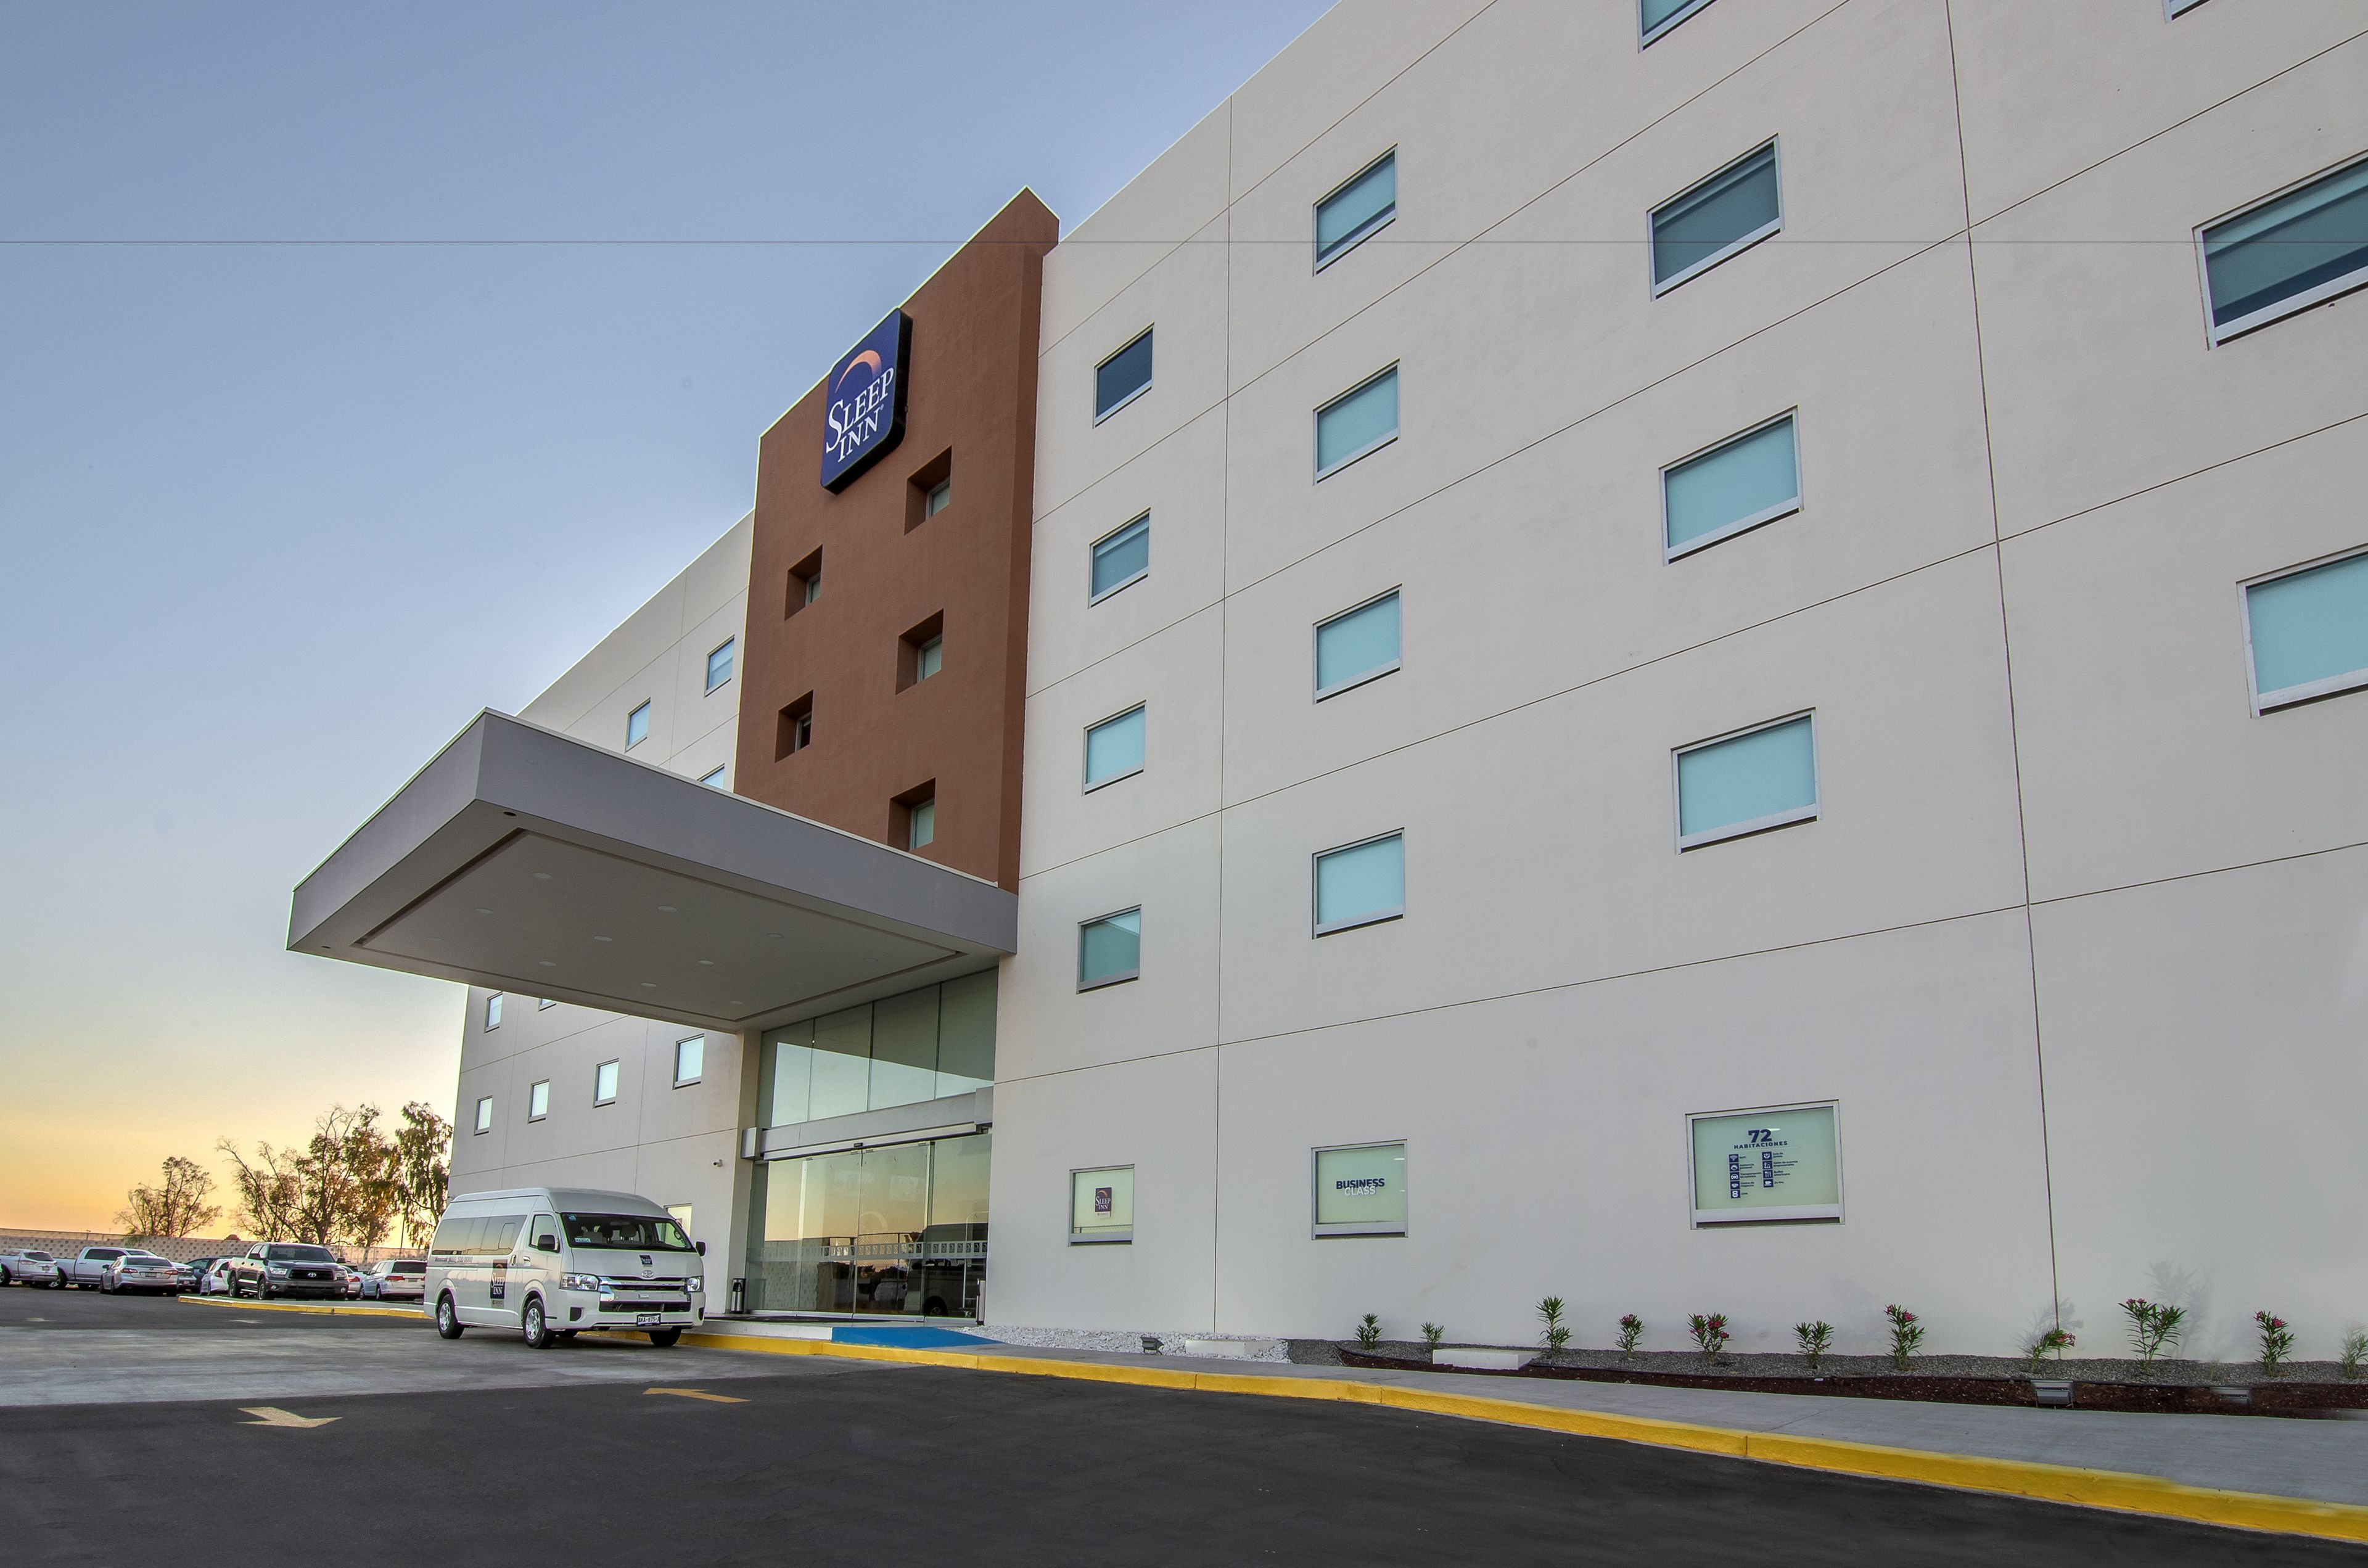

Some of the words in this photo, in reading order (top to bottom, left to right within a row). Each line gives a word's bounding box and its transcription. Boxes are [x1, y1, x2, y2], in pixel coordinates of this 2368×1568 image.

[826, 367, 894, 453] SLEEP
[837, 408, 879, 462] INN
[1748, 1129, 1772, 1143] 72
[1734, 1141, 1788, 1149] HABITACIONES
[1336, 1178, 1384, 1189] BUSINESS
[1344, 1186, 1376, 1196] CLASS
[1096, 1196, 1111, 1206] SLEEP
[491, 1273, 506, 1287] SLEEP
[493, 1287, 503, 1295] INN
